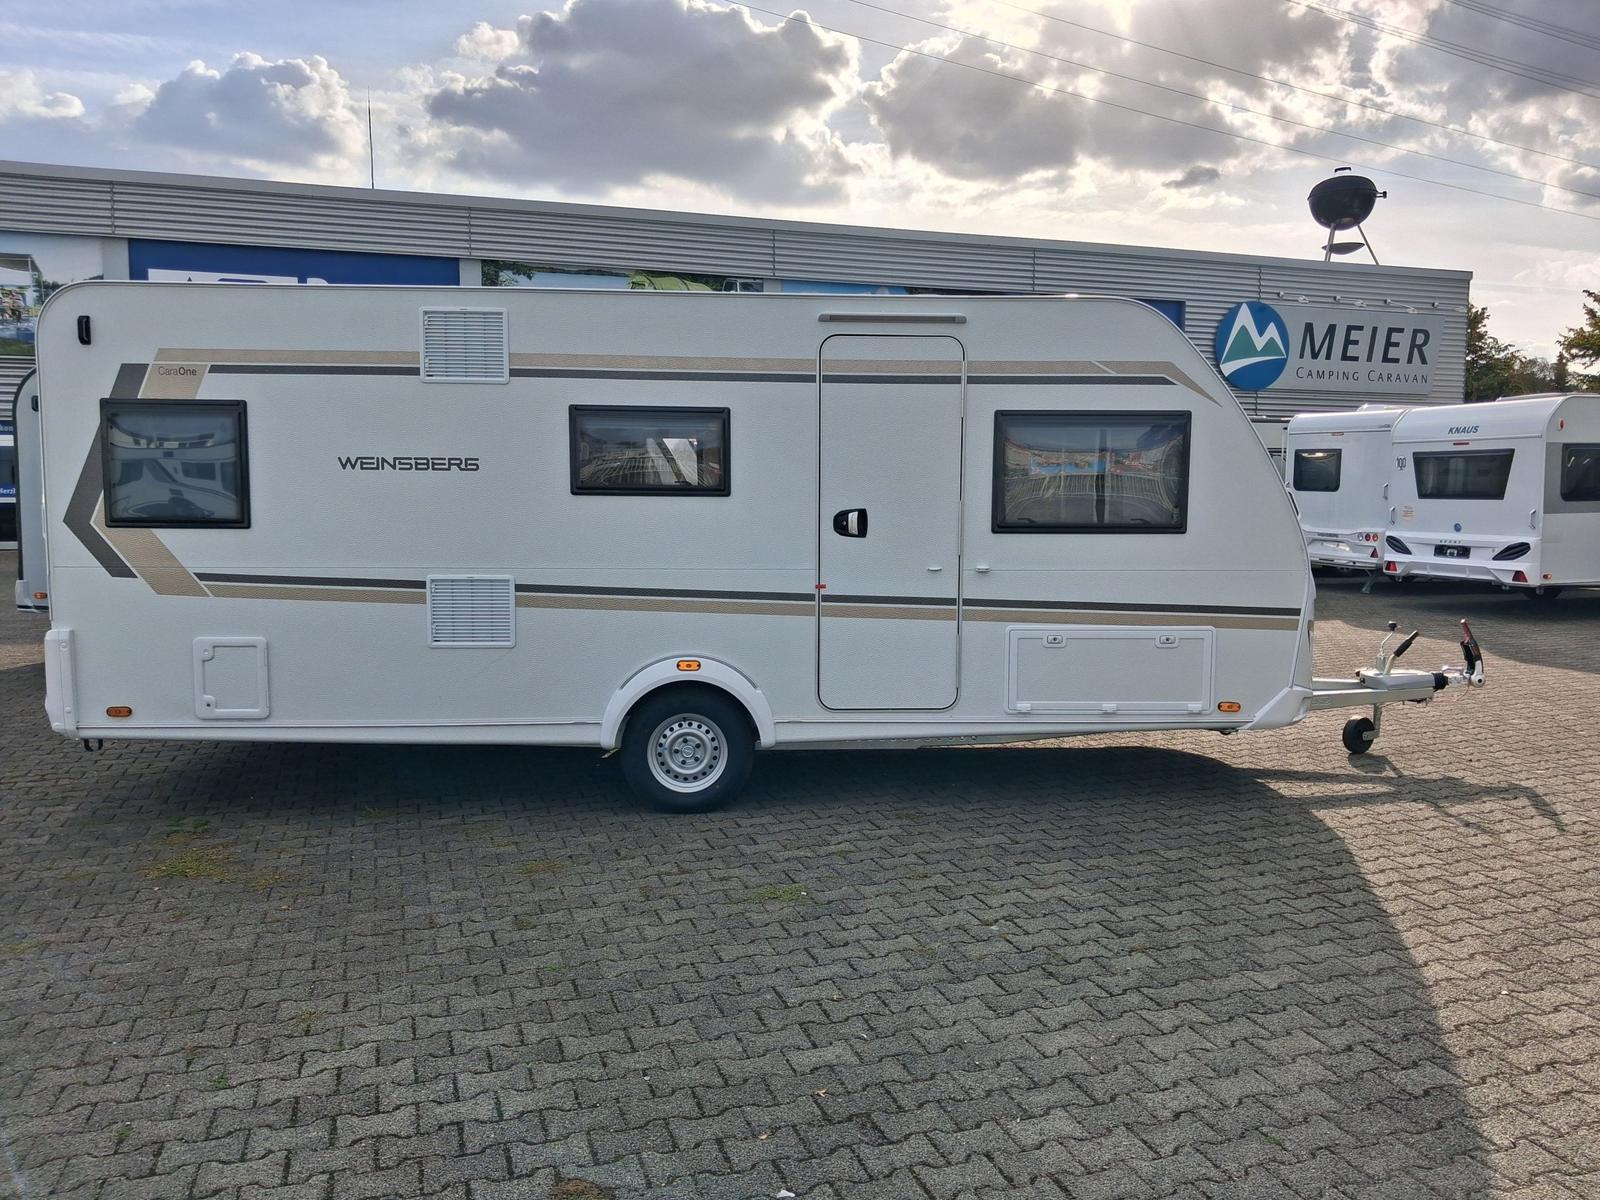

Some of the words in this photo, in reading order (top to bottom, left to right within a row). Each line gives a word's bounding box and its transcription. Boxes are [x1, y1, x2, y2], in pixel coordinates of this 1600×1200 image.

[1299, 322, 1430, 365] MEIER
[158, 366, 197, 376] CaraOne
[1296, 366, 1359, 382] CAMPING
[1367, 369, 1429, 384] CARAVAN
[1448, 425, 1479, 435] KNAUS
[337, 456, 480, 472] WEINSBERG
